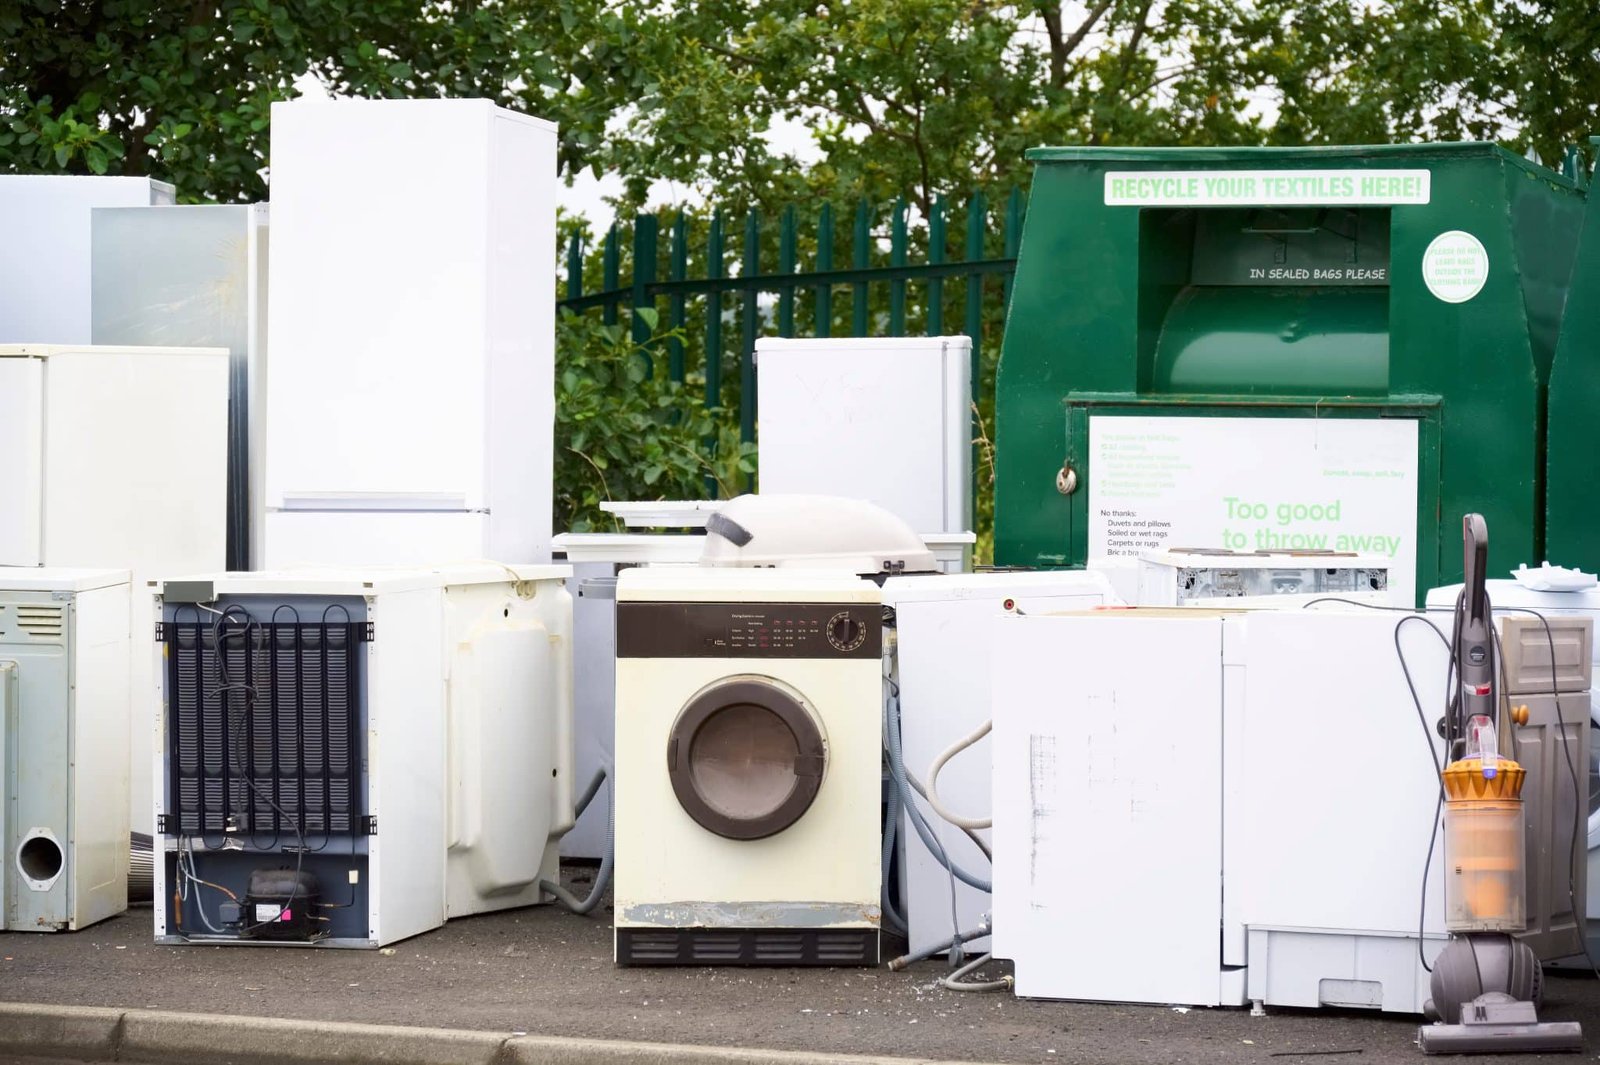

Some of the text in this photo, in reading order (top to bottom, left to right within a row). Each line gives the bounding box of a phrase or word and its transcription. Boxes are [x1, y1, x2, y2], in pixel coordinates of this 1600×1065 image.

[1112, 176, 1422, 198] RECYCLE YOUR TEXTILES HERE!
[1249, 268, 1386, 280] IN SEALED BAGS PLEASE
[1100, 509, 1111, 517] No
[1223, 497, 1341, 526] Too good
[1107, 519, 1131, 527] Duvets
[1147, 520, 1171, 529] pillows
[1107, 529, 1128, 537] Soiled
[1152, 531, 1168, 539] rags
[1107, 539, 1134, 548] Carpets
[1144, 541, 1160, 549] rugs
[1222, 527, 1401, 558] to throw away
[1127, 549, 1144, 557] bra
